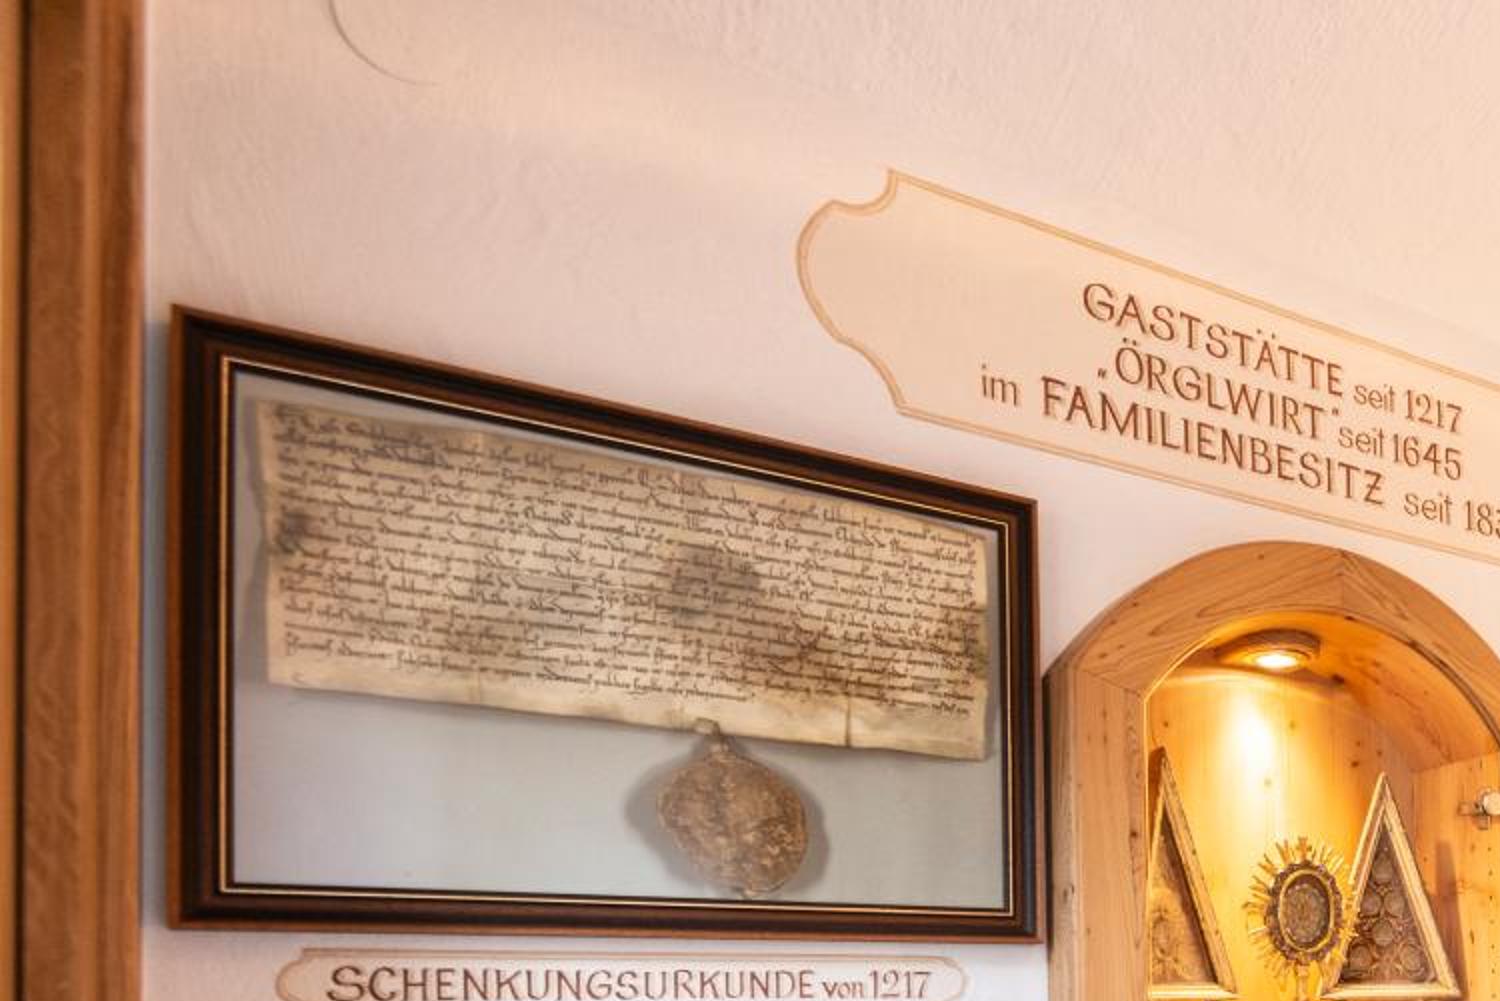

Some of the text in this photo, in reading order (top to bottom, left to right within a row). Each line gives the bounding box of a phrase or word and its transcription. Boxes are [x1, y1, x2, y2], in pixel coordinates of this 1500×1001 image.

[1082, 282, 1463, 433] GASTSTÄTTE seit 1217
[980, 363, 1020, 406] im
[1041, 375, 1384, 505] FAMILIENBESITZ
[1403, 491, 1454, 526] seit
[1338, 427, 1385, 458] seit
[1393, 433, 1462, 481] 1645
[821, 979, 865, 999] von
[868, 969, 932, 1000] 1217
